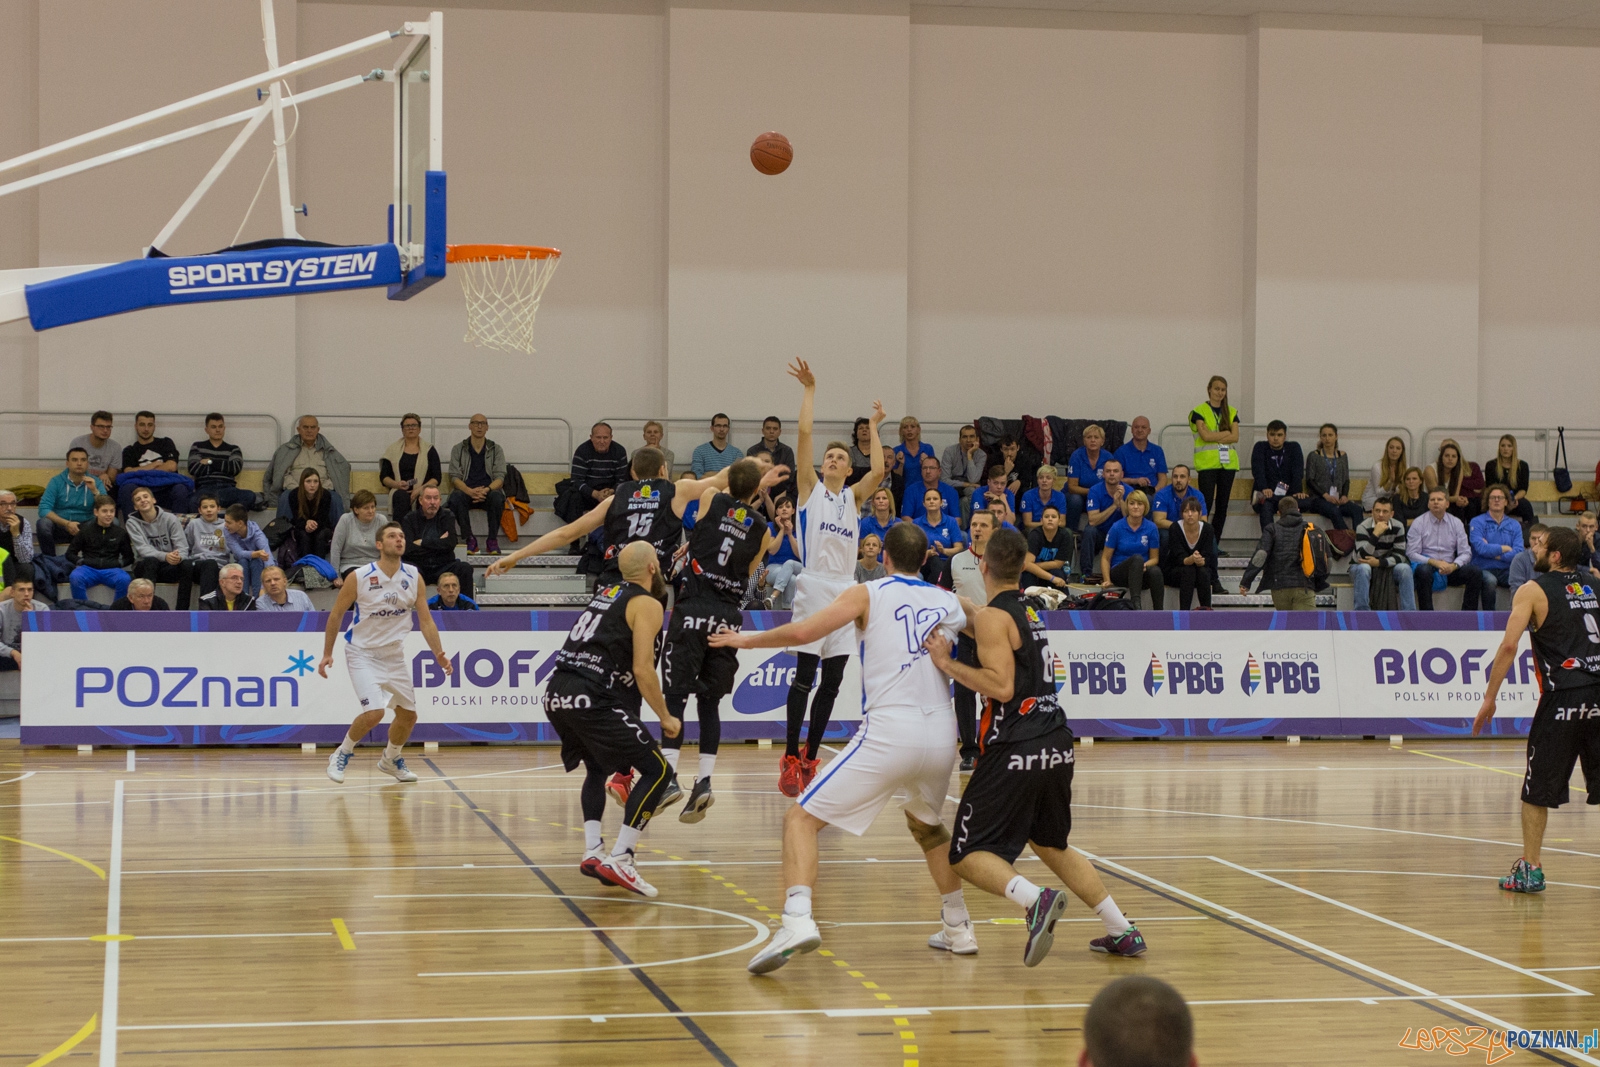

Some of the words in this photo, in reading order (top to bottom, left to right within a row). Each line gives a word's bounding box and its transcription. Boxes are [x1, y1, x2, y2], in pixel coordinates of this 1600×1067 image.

[626, 512, 655, 538] 15
[719, 522, 747, 540] ASTORIA
[717, 537, 735, 567] 5
[384, 592, 399, 605] 11
[569, 610, 604, 643] 84
[894, 604, 949, 655] 12
[1583, 613, 1600, 644] 9
[1067, 651, 1125, 661] fundacja
[1165, 651, 1222, 661] fundacja
[1262, 651, 1318, 661] fundacja
[1069, 661, 1127, 695] PBG
[1167, 661, 1224, 695] PBG
[1264, 661, 1321, 694] PBG
[432, 695, 483, 706] POLSKI
[1394, 691, 1440, 701] POLSKI
